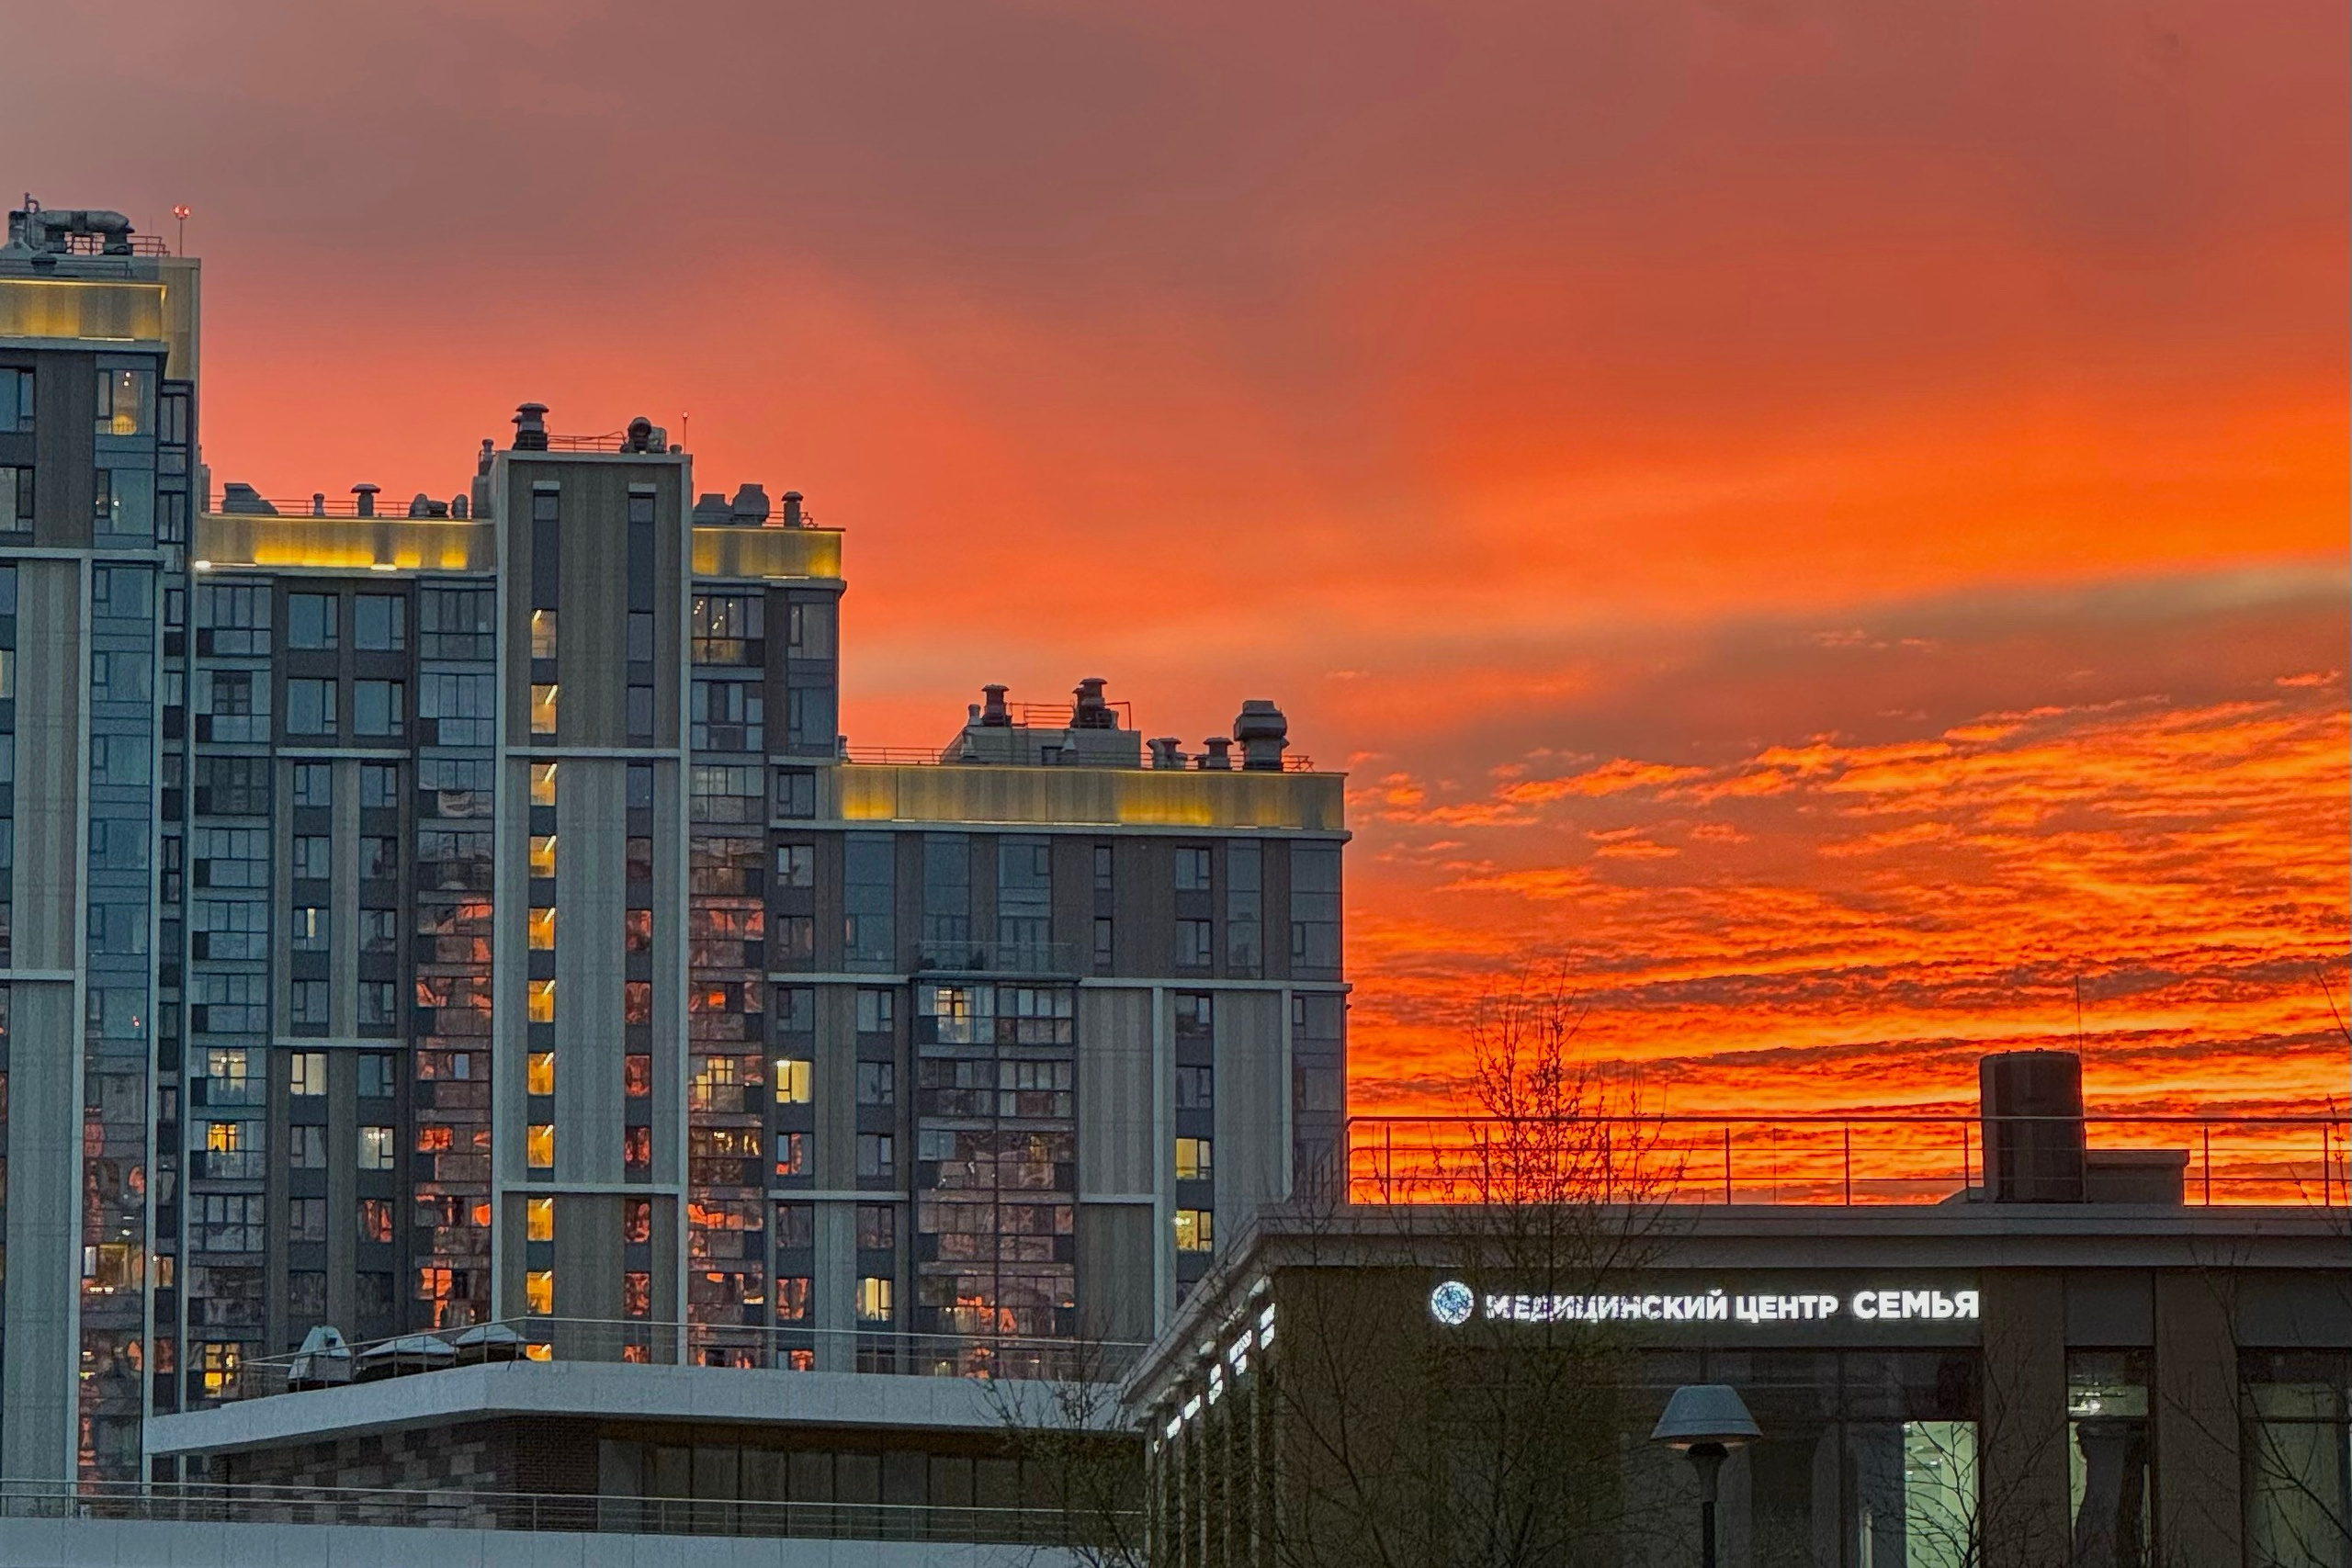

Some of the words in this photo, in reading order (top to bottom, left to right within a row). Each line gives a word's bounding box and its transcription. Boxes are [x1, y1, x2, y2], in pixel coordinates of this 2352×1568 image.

[1486, 1289, 1728, 1323] МЕДИЦИНСКИЙ
[1736, 1295, 1839, 1324] ЦЕНТР
[1852, 1291, 1979, 1319] СЕМЬЯ
